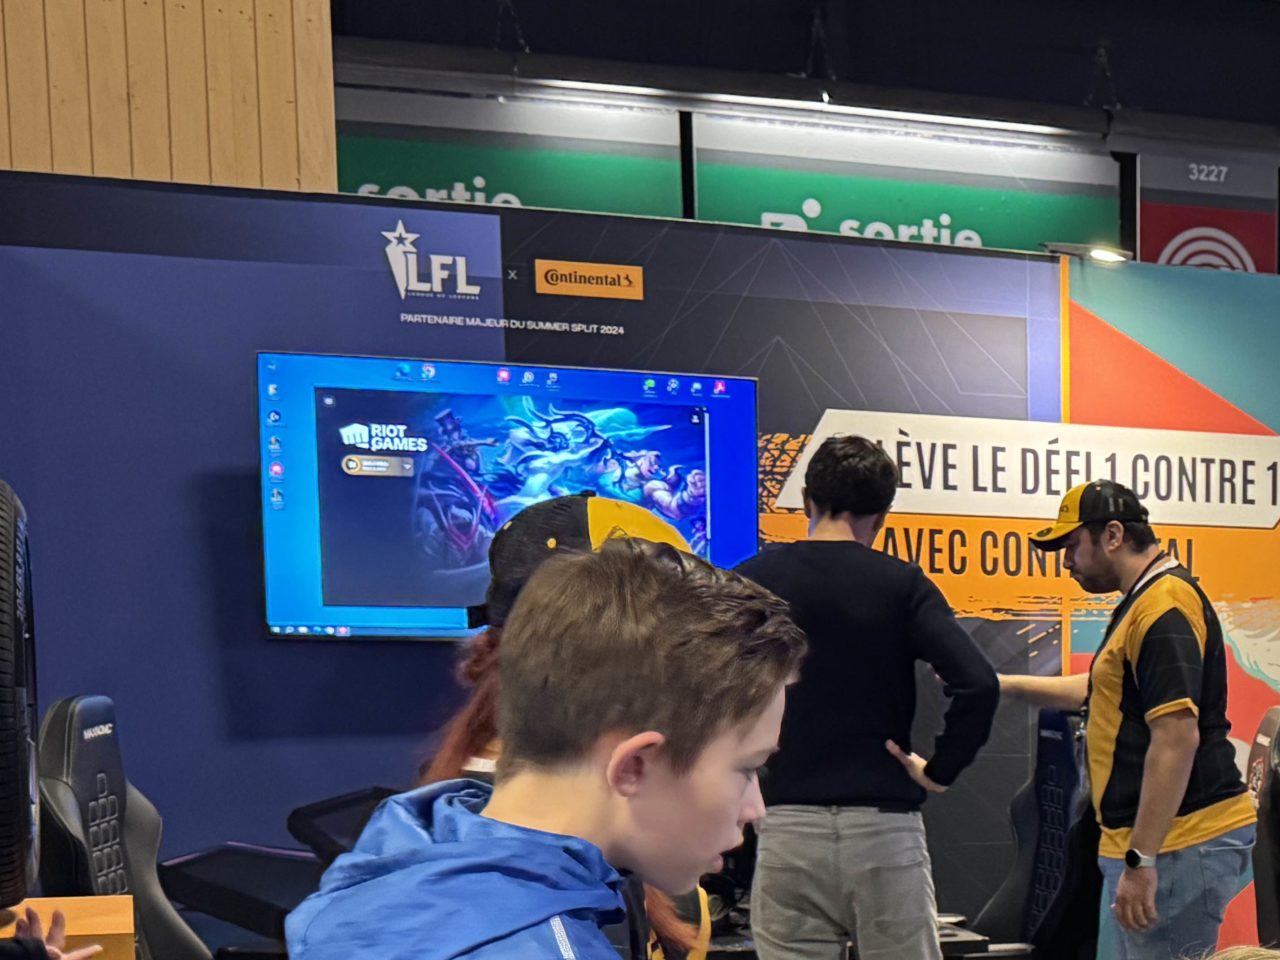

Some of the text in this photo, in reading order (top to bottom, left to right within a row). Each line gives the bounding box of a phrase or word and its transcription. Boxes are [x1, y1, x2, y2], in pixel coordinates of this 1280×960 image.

[1188, 163, 1229, 182] 3227
[406, 251, 481, 294] LFL
[544, 268, 621, 288] Continental
[400, 313, 625, 335] PARTENAIRE MAJEUR DU SUMMER SPLIT 2024
[370, 424, 407, 438] RIOT
[370, 437, 428, 452] GAMES
[876, 428, 958, 491] ÈVE
[972, 445, 1007, 493] LE
[1104, 452, 1117, 484] 1
[1131, 454, 1256, 506] CONTRE
[1267, 461, 1278, 506] 1
[883, 527, 968, 575] AVEC
